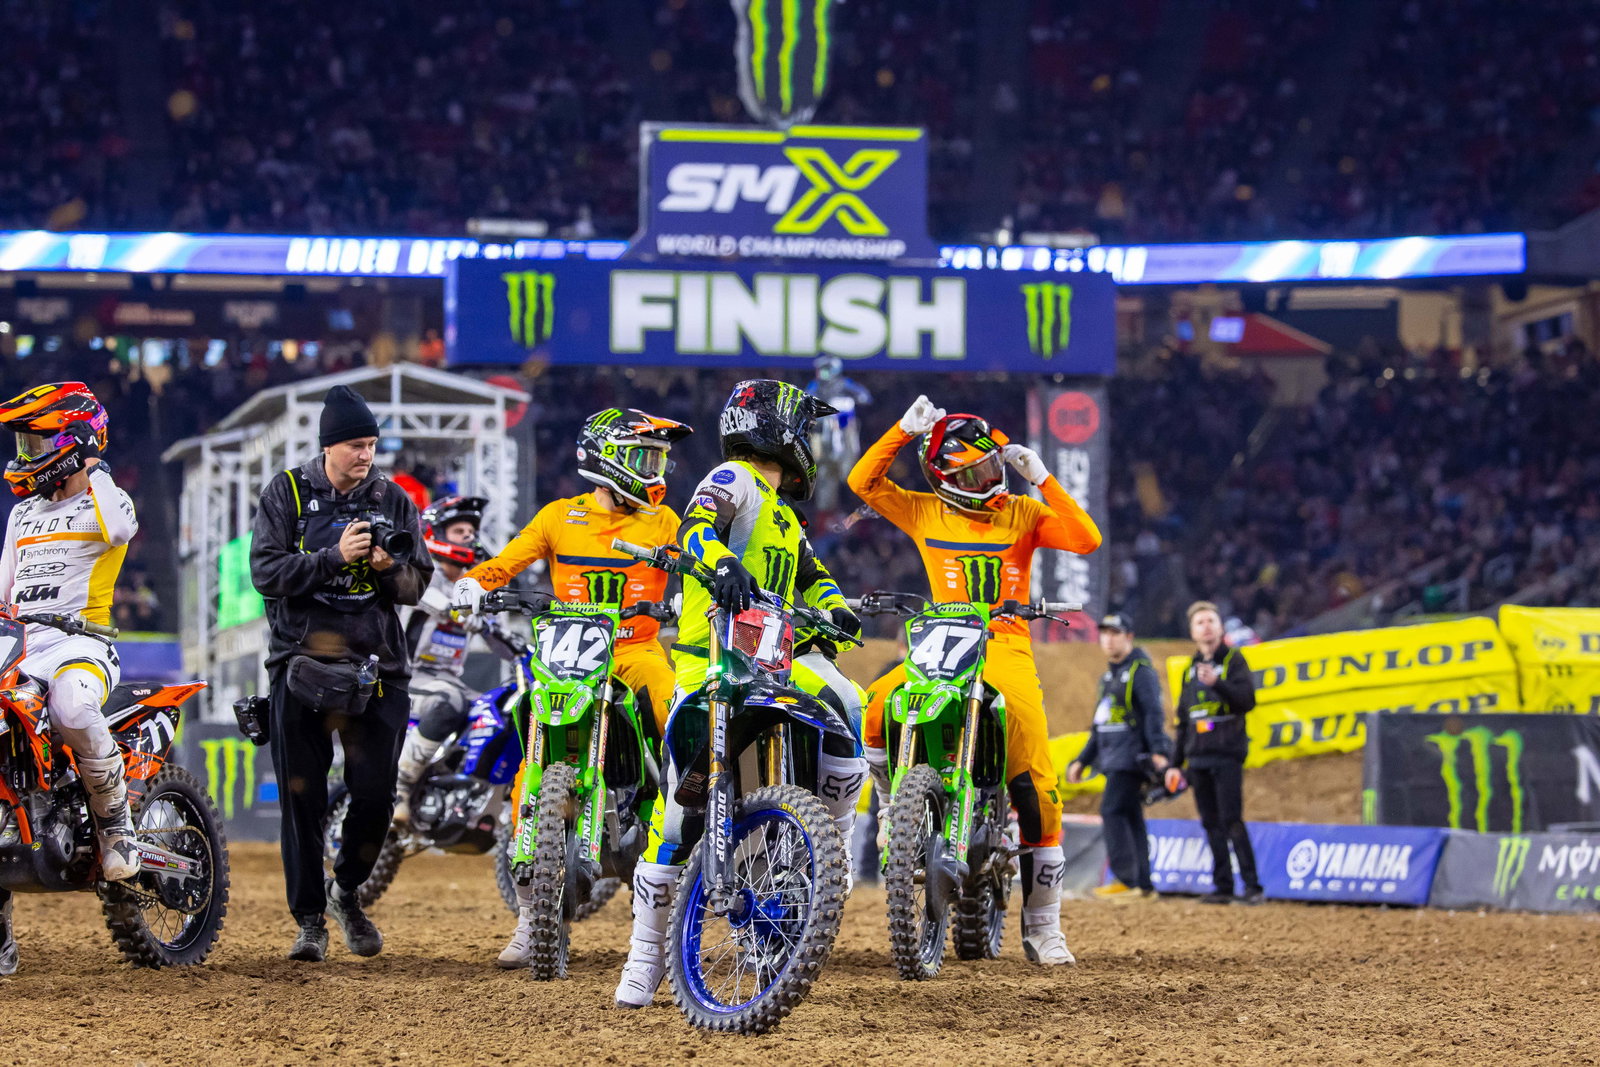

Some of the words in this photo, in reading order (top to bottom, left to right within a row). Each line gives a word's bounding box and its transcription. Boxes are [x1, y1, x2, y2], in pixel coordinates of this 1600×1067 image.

[658, 147, 900, 236] SMX
[657, 235, 736, 256] WORLD
[739, 236, 907, 260] CHAMPIONSHIP
[609, 271, 967, 359] FINISH
[37, 452, 80, 483] synchron
[22, 516, 75, 536] THOR
[27, 547, 70, 560] synchrony
[15, 584, 61, 603] KTM
[539, 624, 610, 671] 142
[755, 616, 782, 661] 1
[911, 625, 982, 670] 47
[1252, 641, 1494, 690] DUNLOP
[522, 793, 537, 856] DNLOP
[716, 790, 727, 863] DUNLOP
[142, 851, 166, 863] ENTHAL
[1315, 842, 1412, 880] YAMAHA
[1289, 880, 1397, 894] RACING
